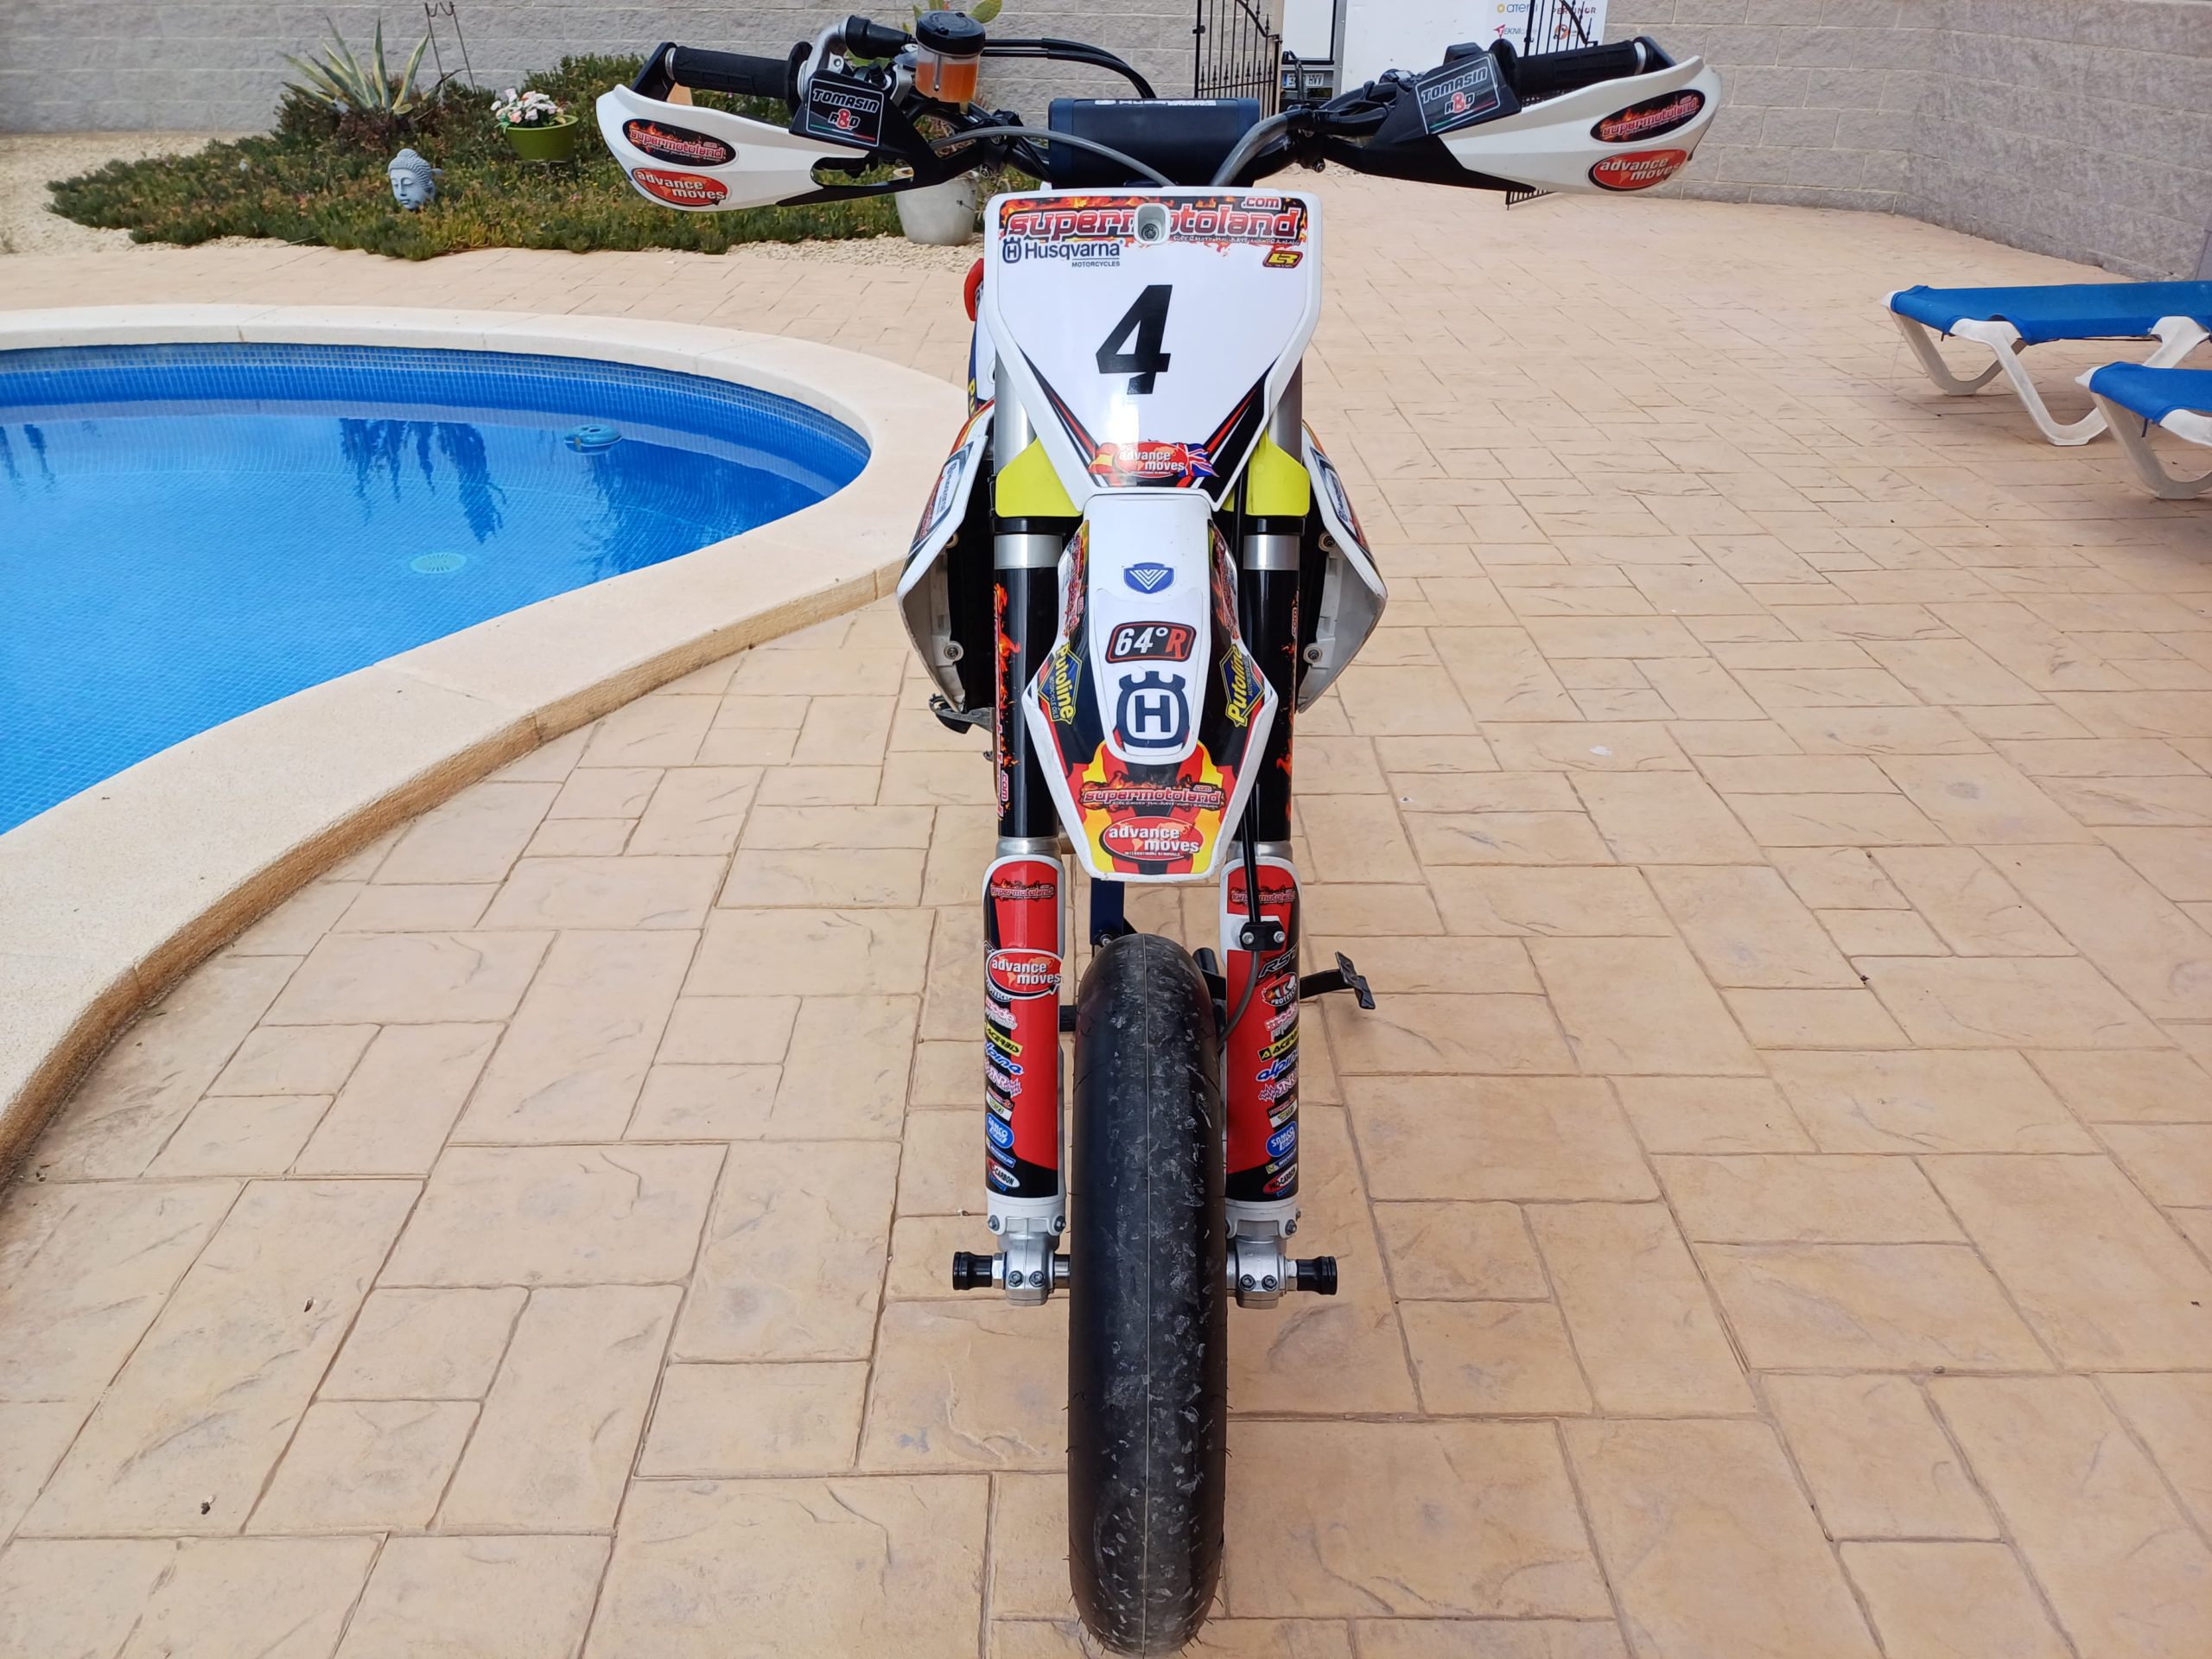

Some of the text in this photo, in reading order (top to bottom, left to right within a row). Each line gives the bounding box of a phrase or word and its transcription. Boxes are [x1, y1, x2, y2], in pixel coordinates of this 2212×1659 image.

[1421, 67, 1487, 104] TOMASIN
[812, 88, 880, 113] TOMASIN
[630, 130, 726, 159] supermotoland
[1600, 157, 1669, 171] advance
[1630, 162, 1681, 181] moves
[637, 171, 704, 189] advance
[671, 188, 727, 200] moves
[1025, 242, 1121, 260] Husqvarna
[1096, 284, 1173, 395] 4
[1119, 449, 1171, 461] advance
[1144, 461, 1185, 472] moves
[1056, 643, 1074, 719] Putoline
[1227, 645, 1247, 724] Putoline
[1084, 787, 1222, 804] supermotoland
[1109, 826, 1179, 839] advance
[1144, 839, 1200, 853] moves
[992, 958, 1047, 973] advance
[1017, 973, 1061, 985] moves
